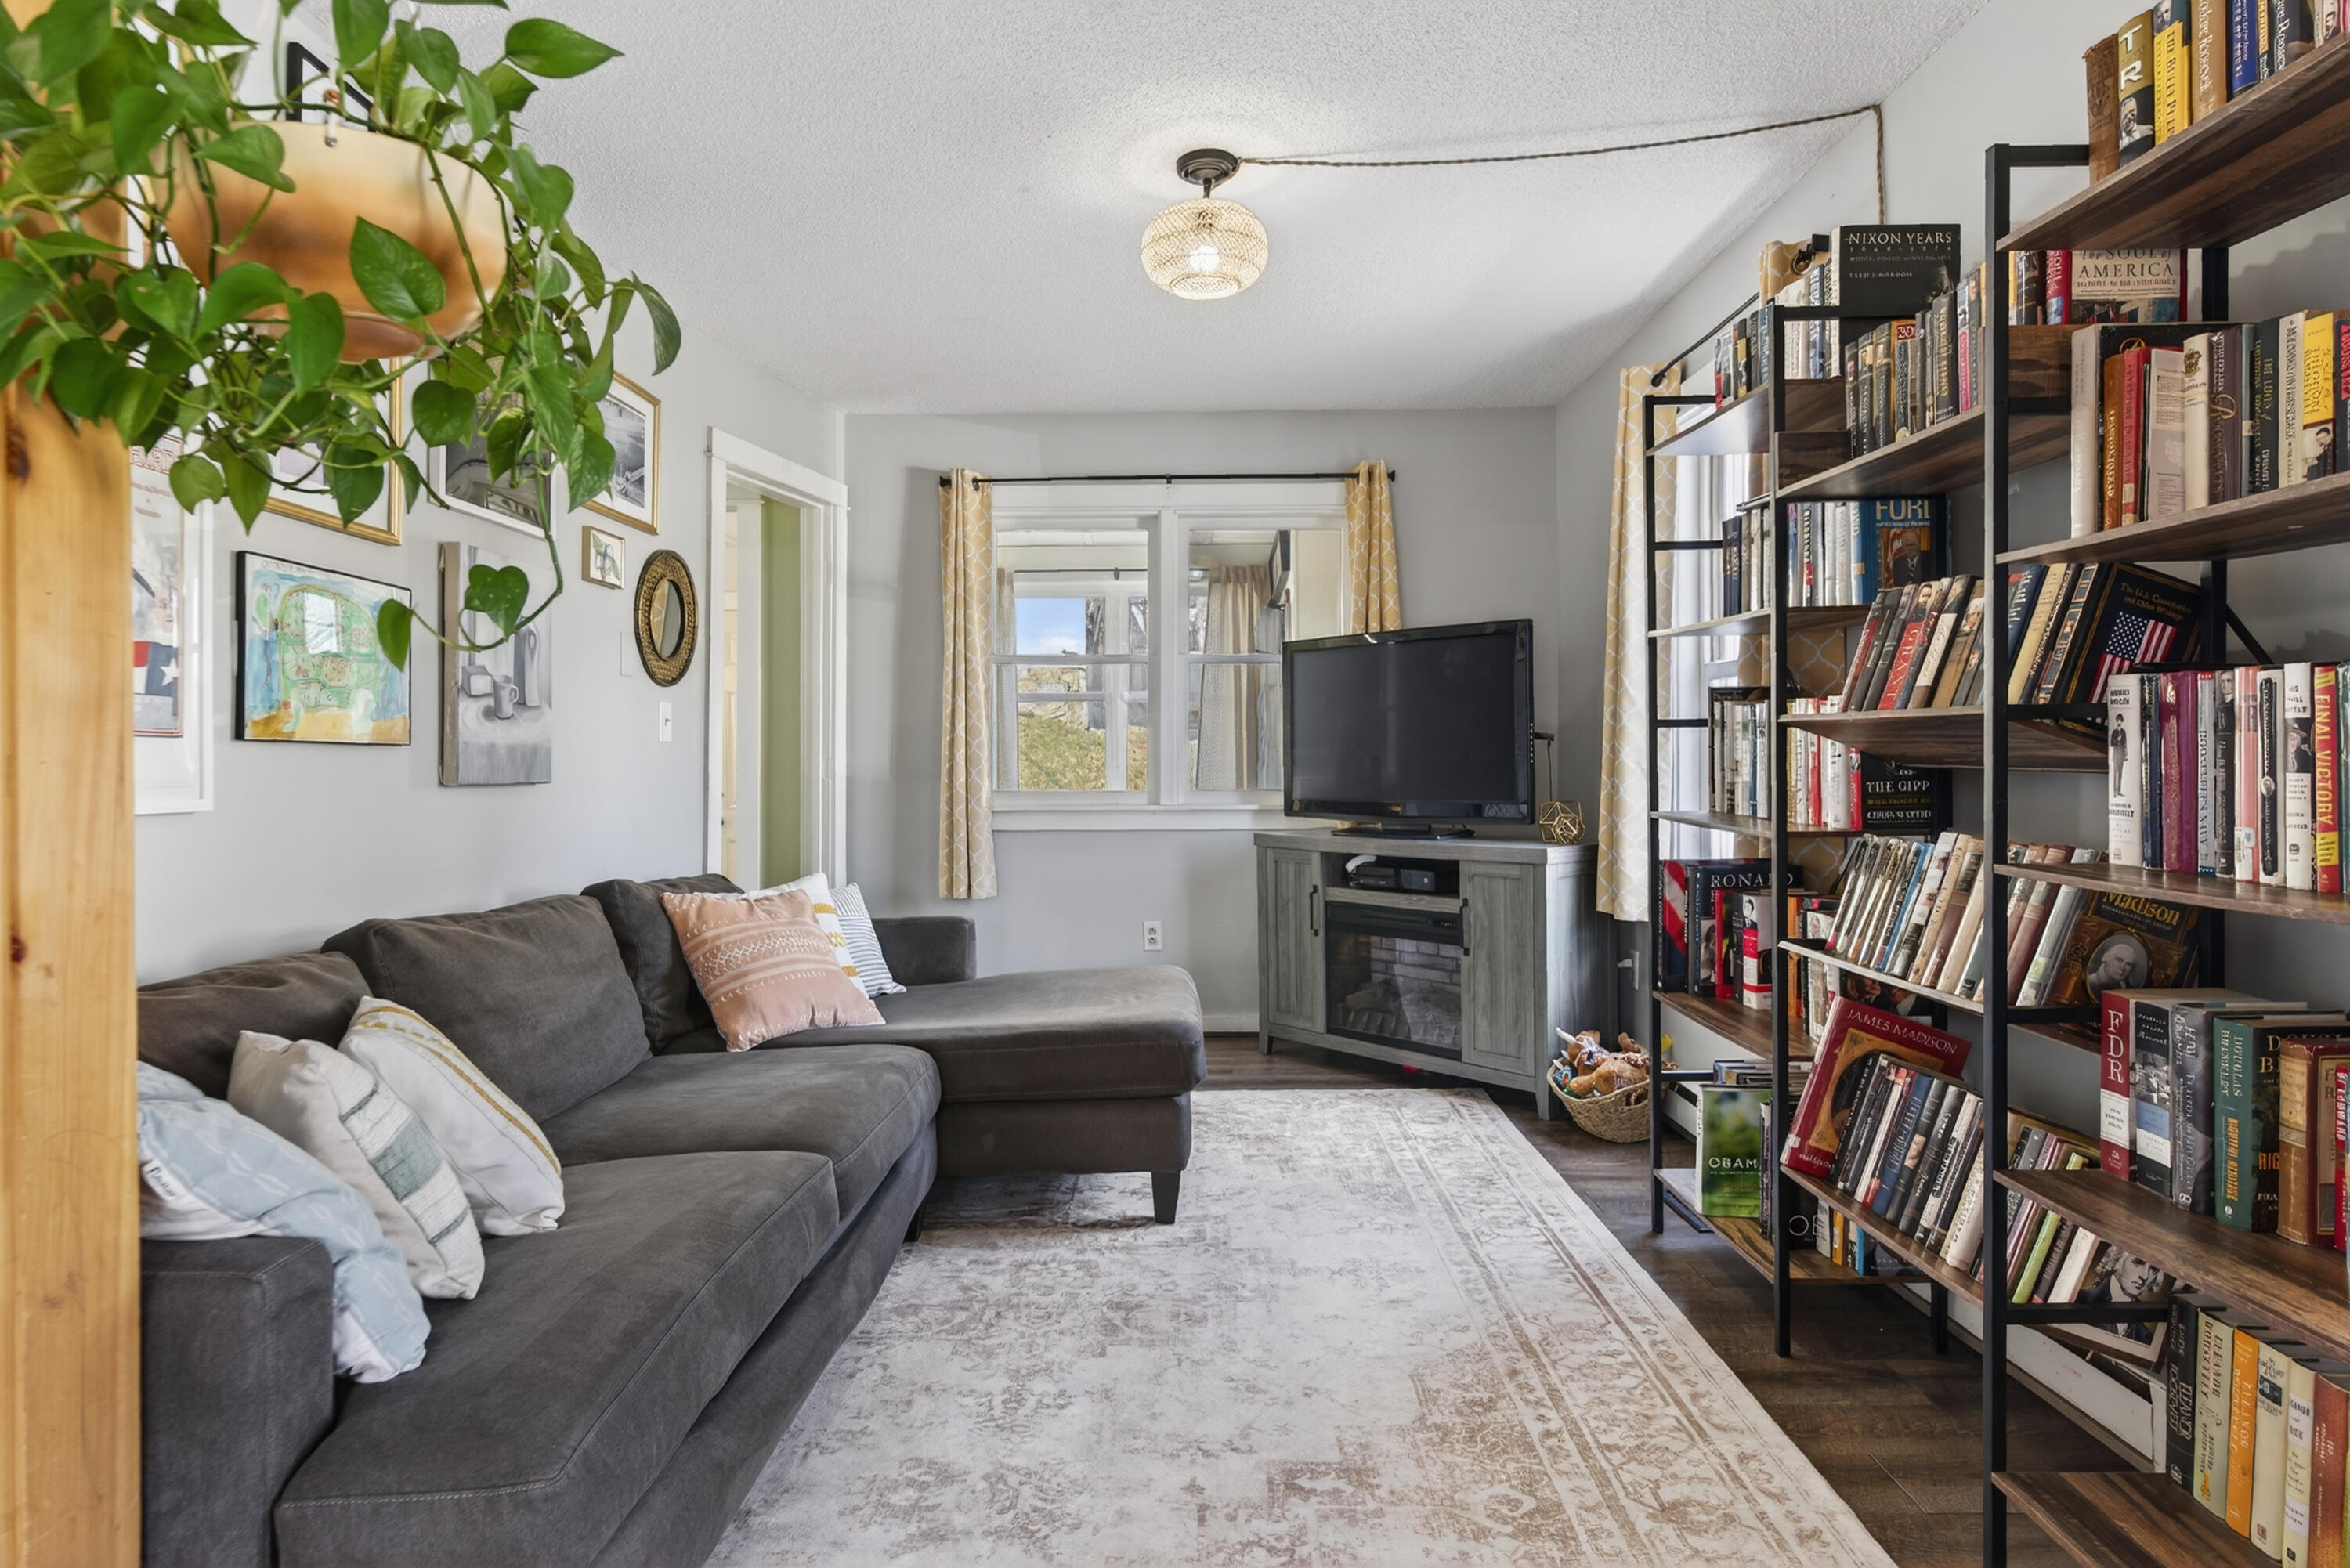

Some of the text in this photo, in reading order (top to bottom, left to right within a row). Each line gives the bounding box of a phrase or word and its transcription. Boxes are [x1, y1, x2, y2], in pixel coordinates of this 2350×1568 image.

[1849, 232, 1952, 244] NIXON YEARS
[2105, 249, 2158, 261] SOUL
[2079, 263, 2175, 279] AMERICA
[2316, 694, 2331, 740] FINAL
[1866, 780, 1930, 793] THE GIPP
[2316, 749, 2335, 826] VICTORY
[1711, 873, 1795, 888] RONA
[1848, 1008, 1959, 1056] JAMES MADISON
[2107, 1009, 2124, 1086] FDR
[1708, 1156, 1758, 1169] OBAM
